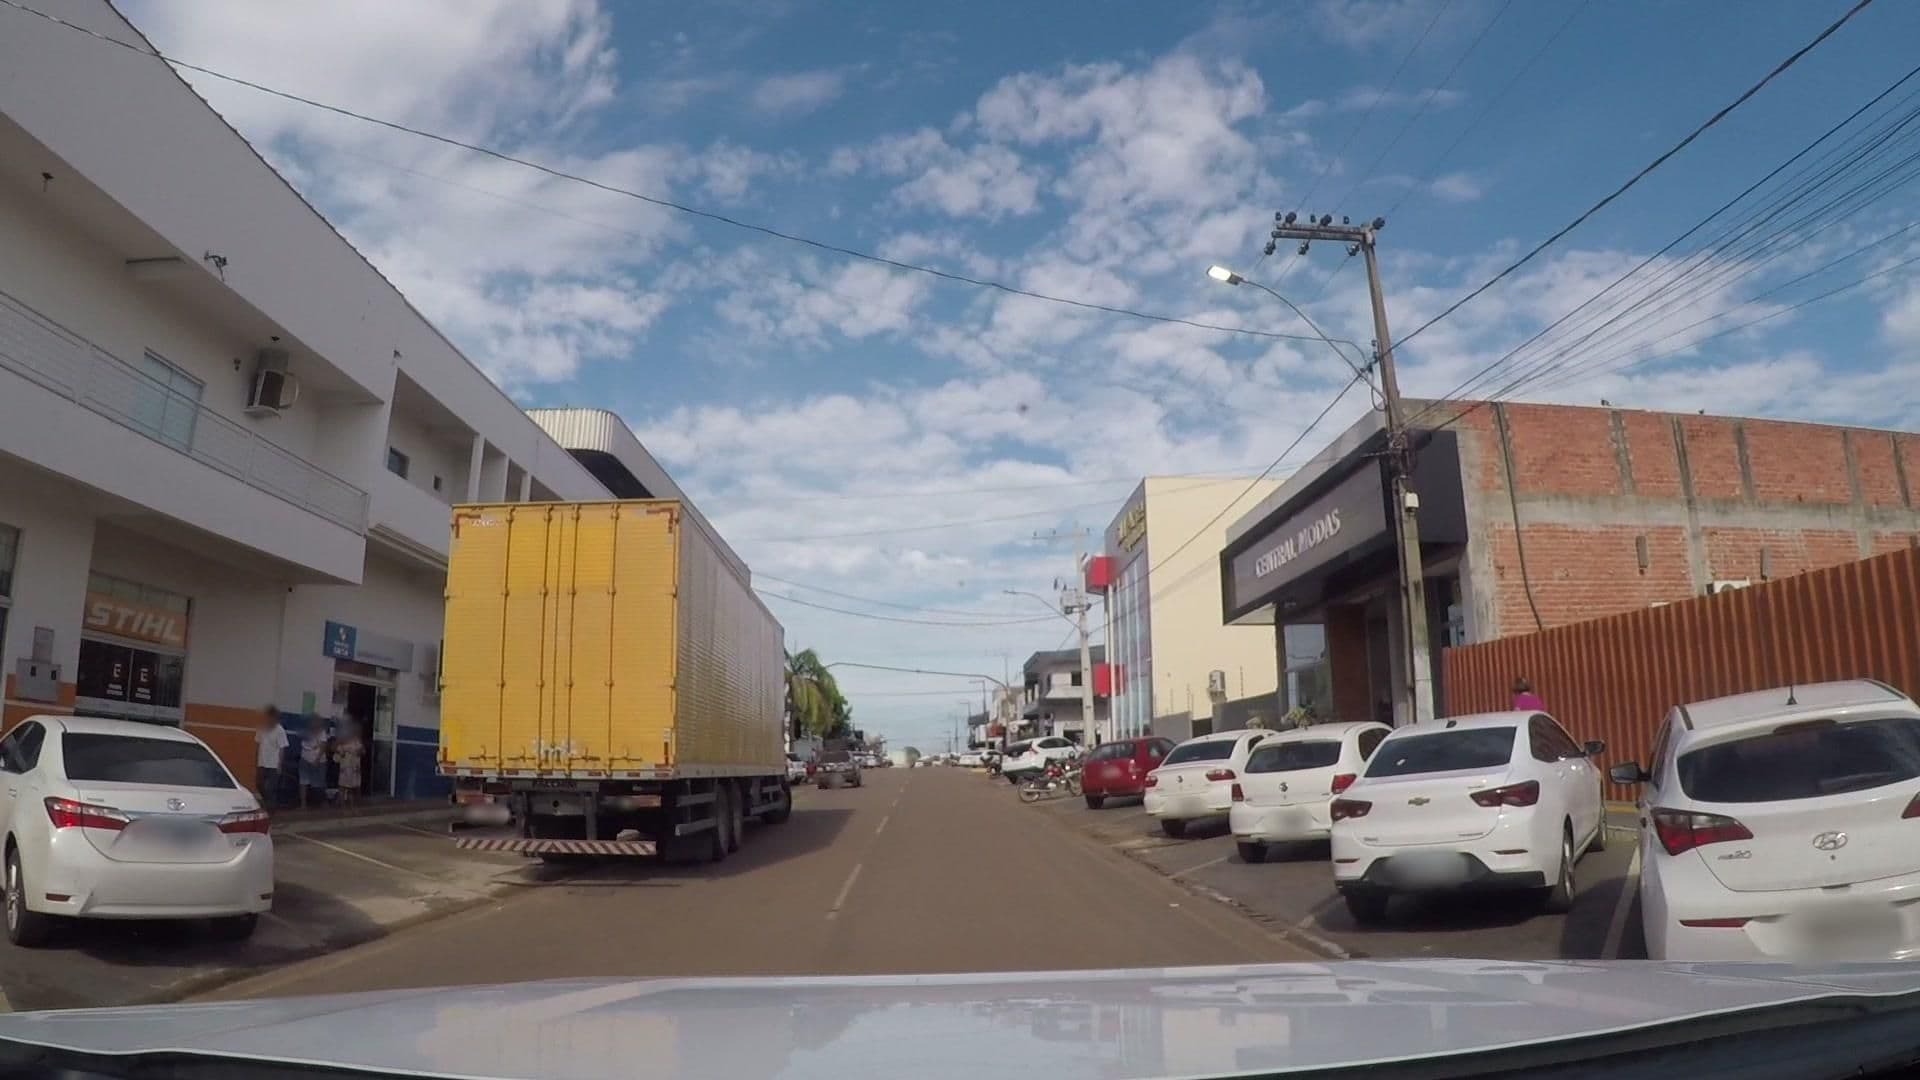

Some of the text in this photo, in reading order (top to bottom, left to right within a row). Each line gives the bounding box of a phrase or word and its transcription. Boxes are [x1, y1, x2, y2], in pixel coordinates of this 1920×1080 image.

[1255, 507, 1341, 578] CENTRAL MODAS
[86, 601, 182, 643] STIHL
